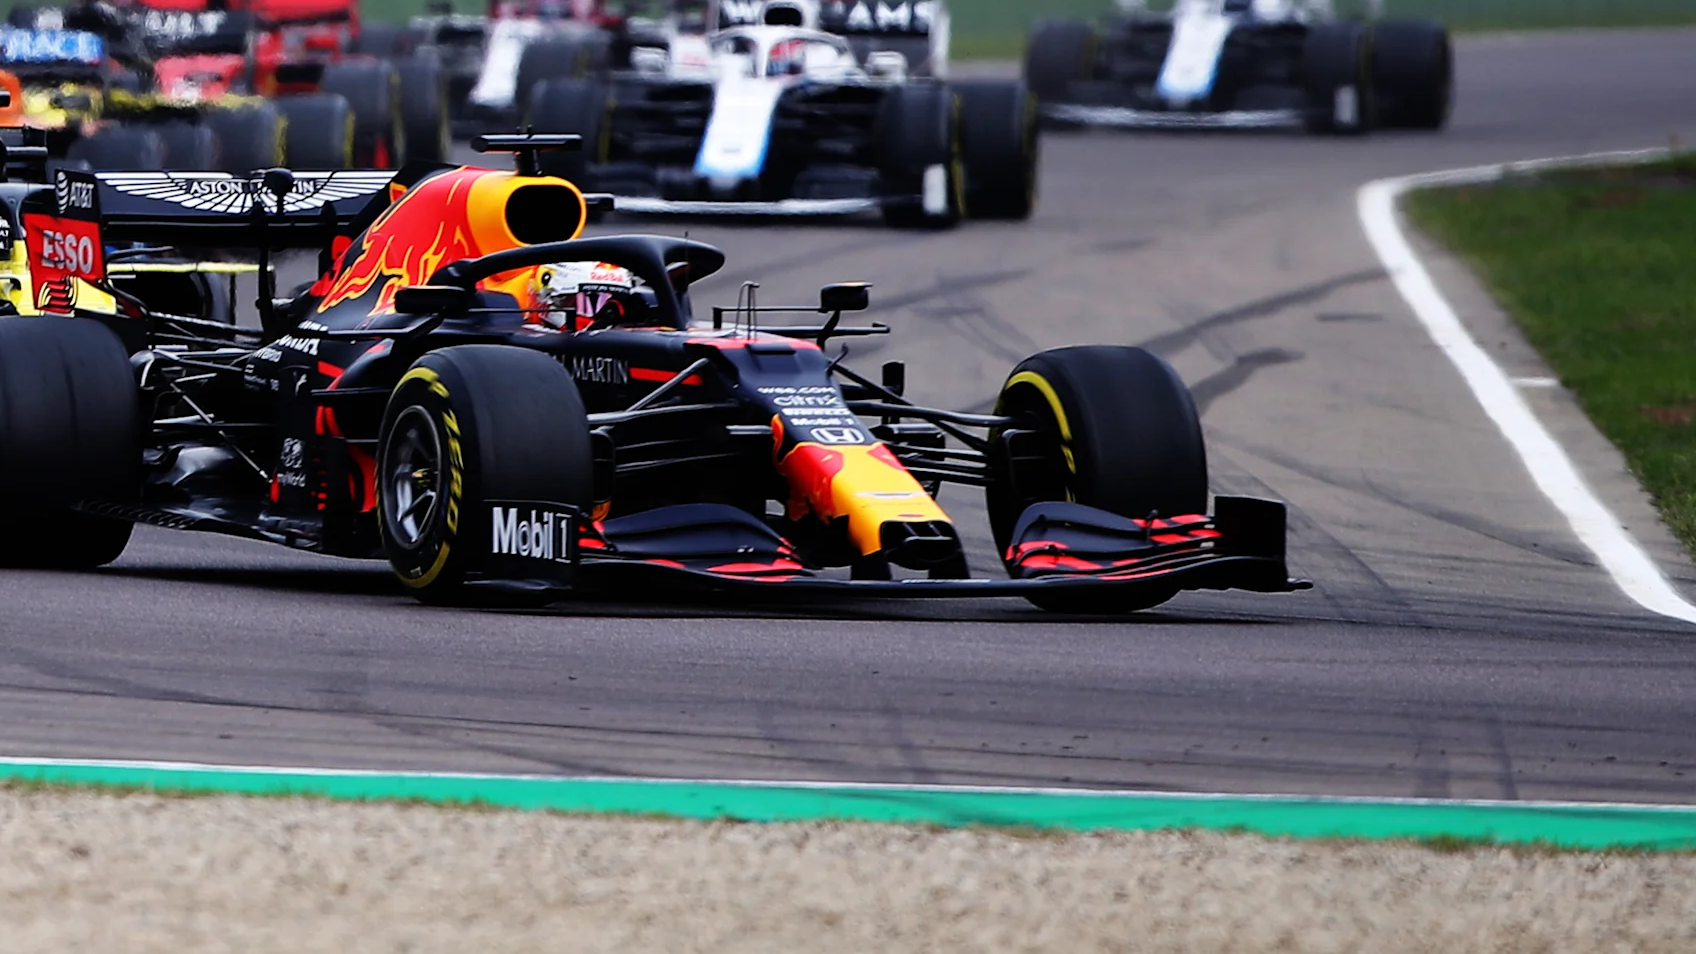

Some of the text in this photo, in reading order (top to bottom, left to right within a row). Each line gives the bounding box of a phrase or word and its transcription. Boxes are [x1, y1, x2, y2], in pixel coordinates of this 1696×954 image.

[68, 181, 95, 209] AT&T
[190, 180, 243, 195] ASTON
[41, 230, 94, 275] ESSO
[570, 356, 629, 384] MARTIN
[491, 506, 554, 560] Mobil
